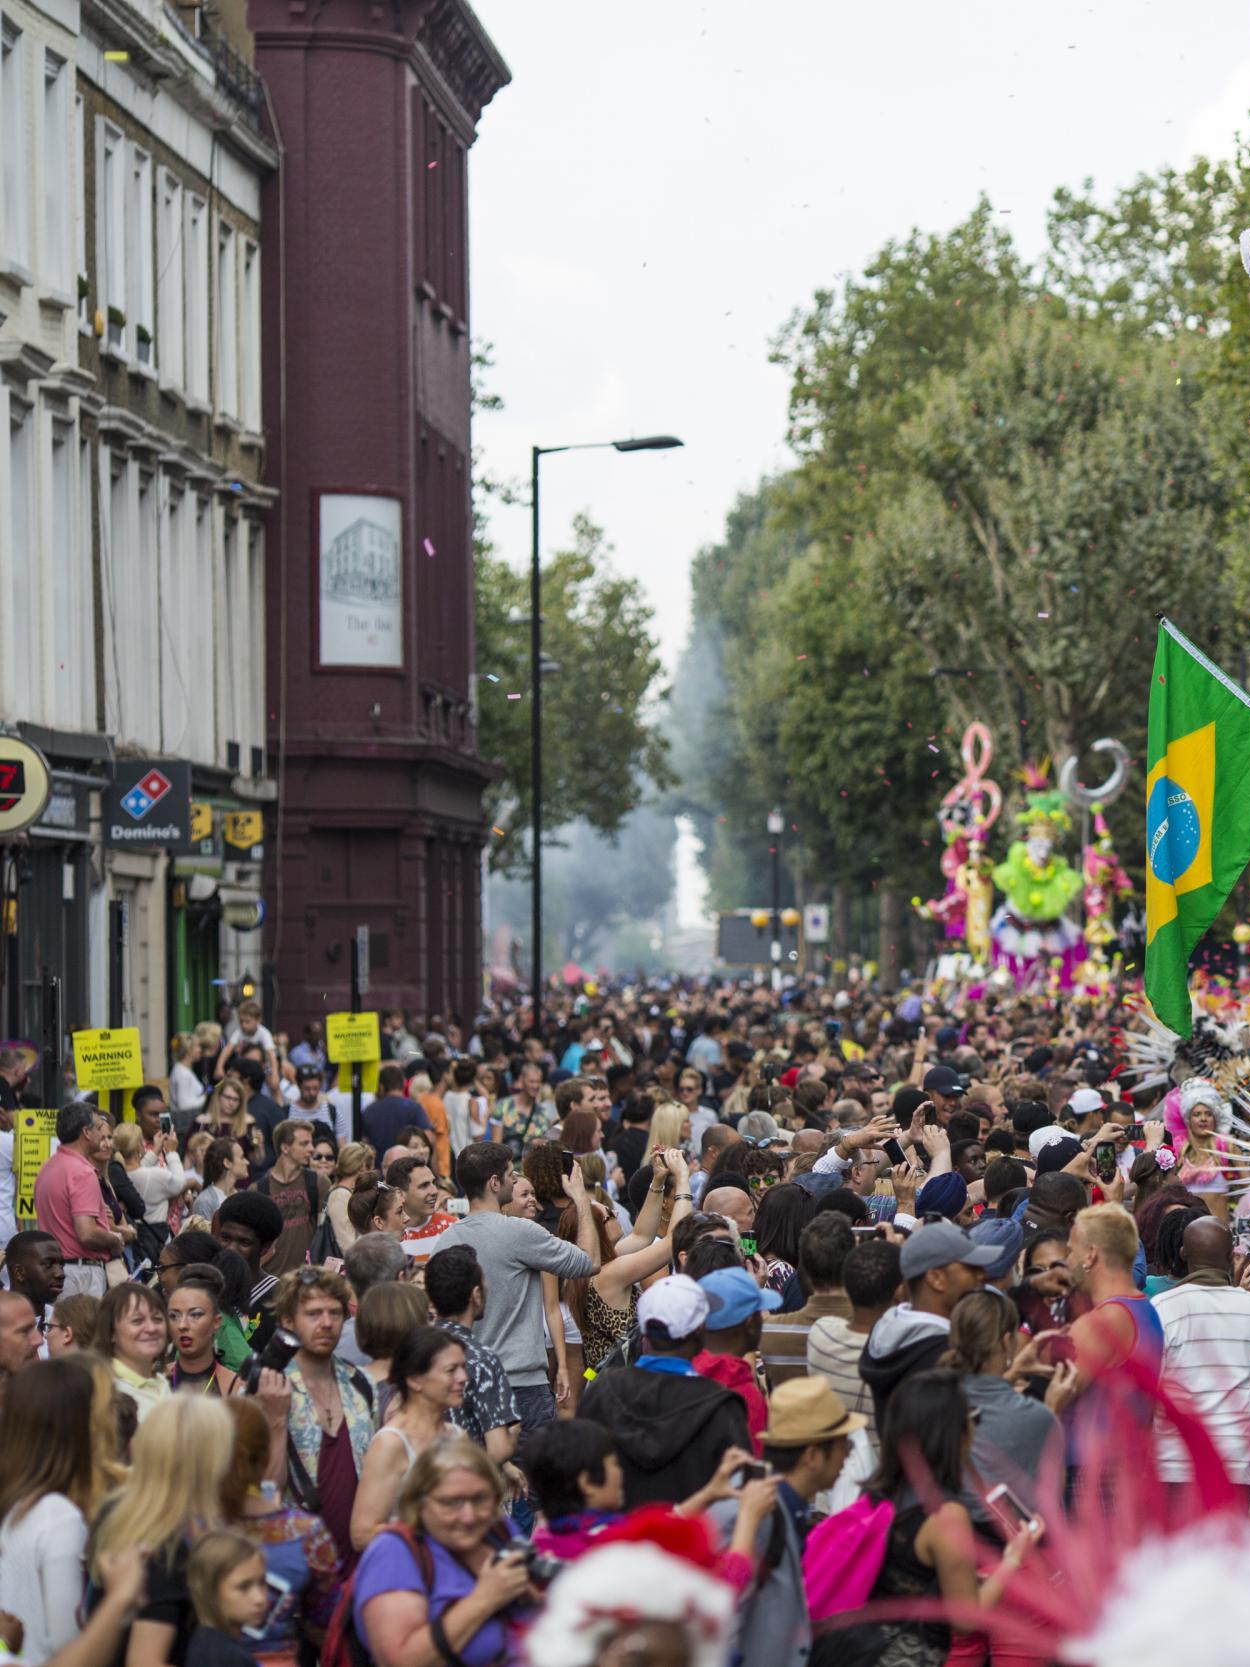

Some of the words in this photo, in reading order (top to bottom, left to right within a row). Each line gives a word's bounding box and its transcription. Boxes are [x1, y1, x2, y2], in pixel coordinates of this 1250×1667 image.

[1168, 794, 1186, 805] SSO
[111, 823, 180, 840] Domino's
[82, 1050, 133, 1063] WARNING
[35, 1110, 58, 1119] WAR
[23, 1160, 41, 1168] place
[19, 1197, 34, 1215] N
